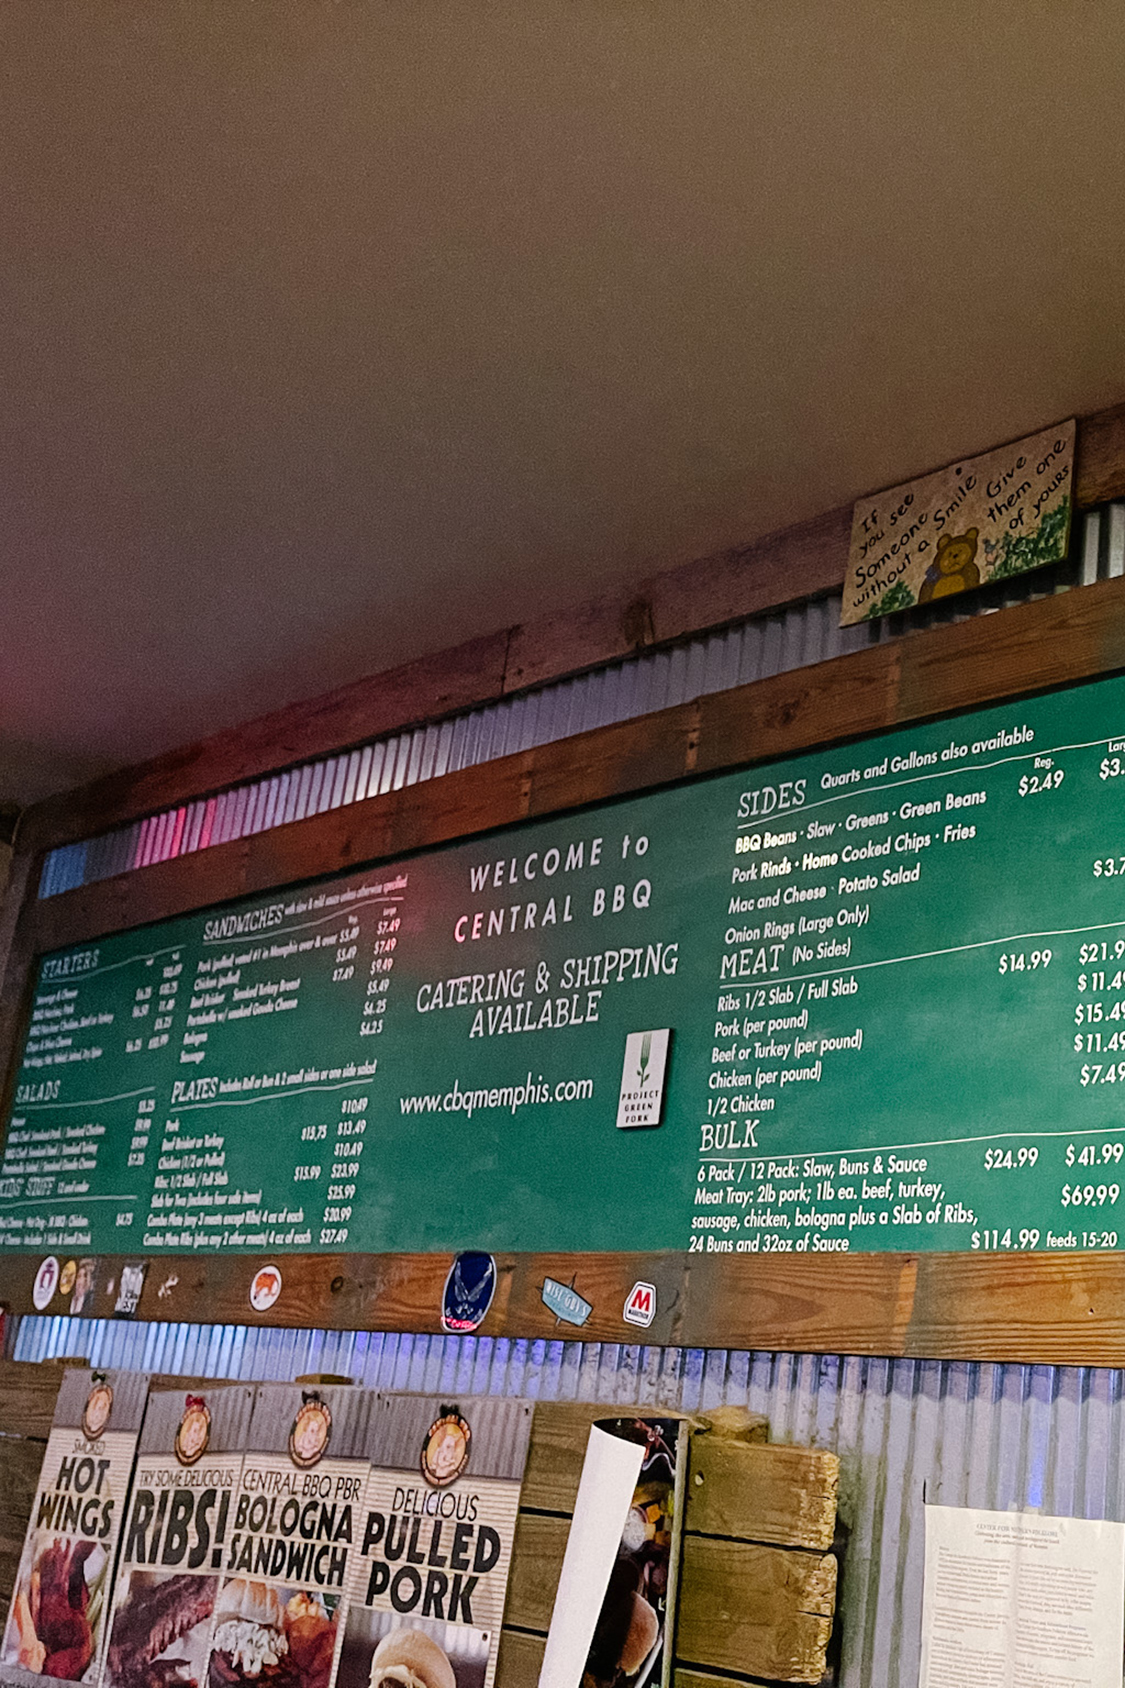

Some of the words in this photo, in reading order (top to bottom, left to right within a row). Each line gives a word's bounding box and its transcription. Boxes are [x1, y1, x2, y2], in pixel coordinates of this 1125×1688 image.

[987, 456, 1026, 498] Give
[987, 480, 1031, 522] them
[1036, 439, 1065, 474] one
[859, 530, 885, 558] you
[890, 493, 914, 526] see
[861, 510, 878, 534] If
[1009, 507, 1024, 529] of
[853, 552, 912, 607] without
[918, 541, 930, 552] a
[934, 475, 977, 531] Smile
[855, 512, 929, 588] Someone
[737, 779, 806, 818] SIDES
[820, 769, 860, 789] Quarts
[864, 758, 888, 779] and
[890, 751, 938, 773] Gallons
[941, 742, 968, 761] also
[971, 724, 1034, 754] available
[1034, 757, 1054, 770] Reg.
[1018, 770, 1064, 797] $2.49
[470, 838, 602, 892] WELCOME
[622, 835, 648, 859] to
[203, 904, 285, 940] SANDWICHES
[455, 895, 572, 942] CENTRAL
[592, 879, 651, 916] BBQ
[725, 926, 760, 944] Onion
[763, 921, 795, 940] Rings
[798, 916, 834, 936] (Large
[837, 904, 869, 927] Only)
[377, 918, 400, 935] $7.49
[374, 938, 396, 955] $7.49
[720, 944, 785, 979] MEAT
[792, 945, 814, 966] (No
[816, 937, 851, 959] Sides)
[998, 949, 1052, 975] $14.99
[41, 949, 100, 979] STARTERS
[370, 958, 393, 976] $9.49
[417, 968, 525, 1012] CATERING
[535, 961, 550, 994] &
[560, 942, 678, 989] SHIPPING
[469, 990, 602, 1038] AVAILABLE
[714, 1018, 740, 1038] Pork
[743, 1017, 766, 1039] (per
[767, 1009, 808, 1036] pound)
[16, 1080, 61, 1103] SALADS
[171, 1076, 218, 1104] PLATES
[400, 1072, 593, 1118] www.cbqmemphis.com
[622, 1090, 660, 1100] PROJECT
[624, 1102, 652, 1112] GREEN
[626, 1114, 649, 1123] FORK
[337, 1119, 366, 1136] $13.49
[699, 1119, 760, 1152] BULK
[334, 1142, 363, 1157] $10.49
[330, 1162, 359, 1178] $23.99
[327, 1184, 356, 1200] $25.99
[323, 1206, 352, 1223] $20.99
[320, 1228, 348, 1244] $27.49
[971, 1228, 1040, 1250] $114.99
[1046, 1230, 1077, 1248] feeds
[1082, 1232, 1118, 1247] 15-20
[632, 1289, 651, 1312] M
[56, 1456, 110, 1495] HOT
[140, 1470, 154, 1486] TRY
[156, 1470, 182, 1487] SOME
[184, 1469, 234, 1488] DELICIOUS
[242, 1469, 299, 1496] CENTRAL
[302, 1475, 333, 1498] BBQ
[336, 1478, 362, 1502] PBR
[36, 1492, 115, 1538] WINGS
[234, 1493, 352, 1544] BOLOGNA
[392, 1487, 480, 1522] DELICIOUS
[124, 1489, 231, 1569] RIBS!
[360, 1511, 501, 1574] PULLED
[227, 1532, 348, 1587] SANDWICH
[364, 1560, 480, 1625] PORK
